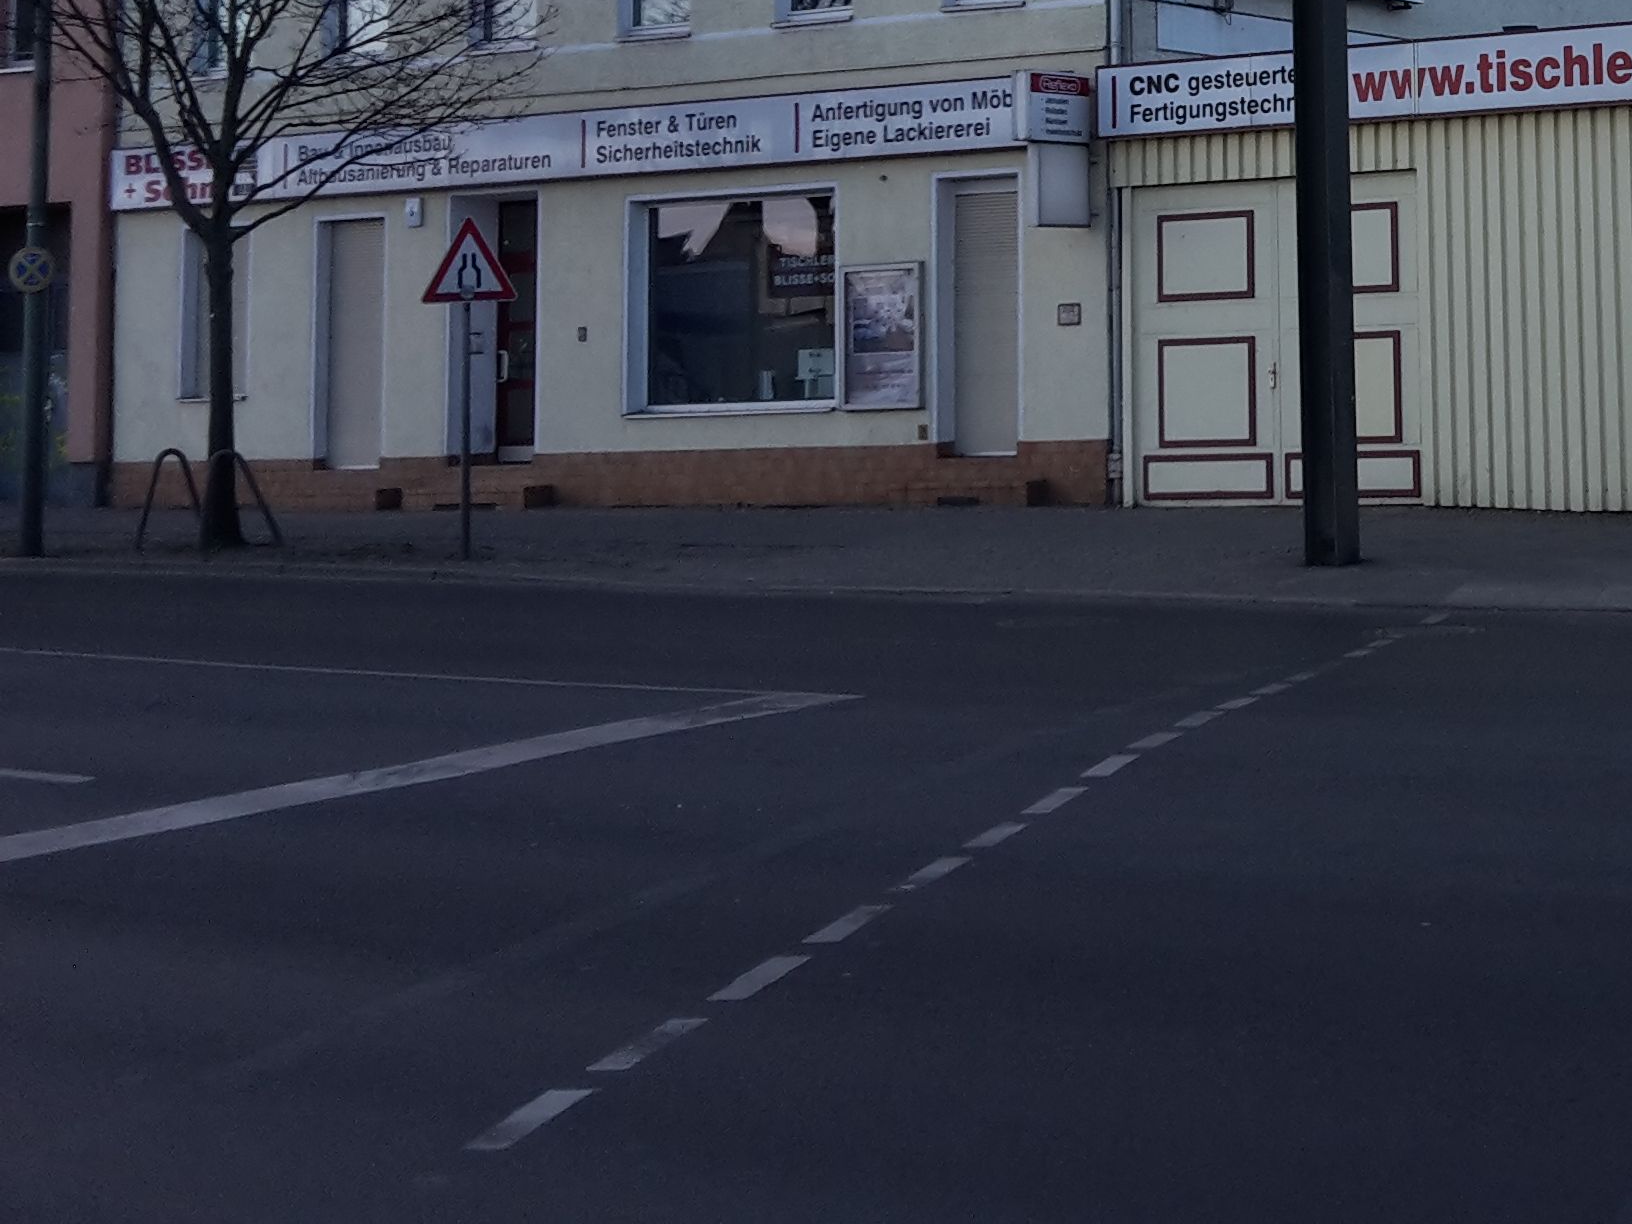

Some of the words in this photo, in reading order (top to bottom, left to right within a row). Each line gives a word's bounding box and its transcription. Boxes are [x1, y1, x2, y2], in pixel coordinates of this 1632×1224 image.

[1129, 73, 1180, 96] CNC
[596, 116, 662, 138] Fenster
[667, 114, 680, 134] &
[684, 109, 738, 132] Türen
[811, 98, 924, 126] Anfertigung
[929, 95, 966, 114] von
[812, 125, 877, 151] Eigene
[883, 117, 991, 144] Lackiererei
[595, 134, 762, 164] Sicherheitstechnik
[431, 160, 443, 176] &
[448, 152, 552, 178] Reparaturen
